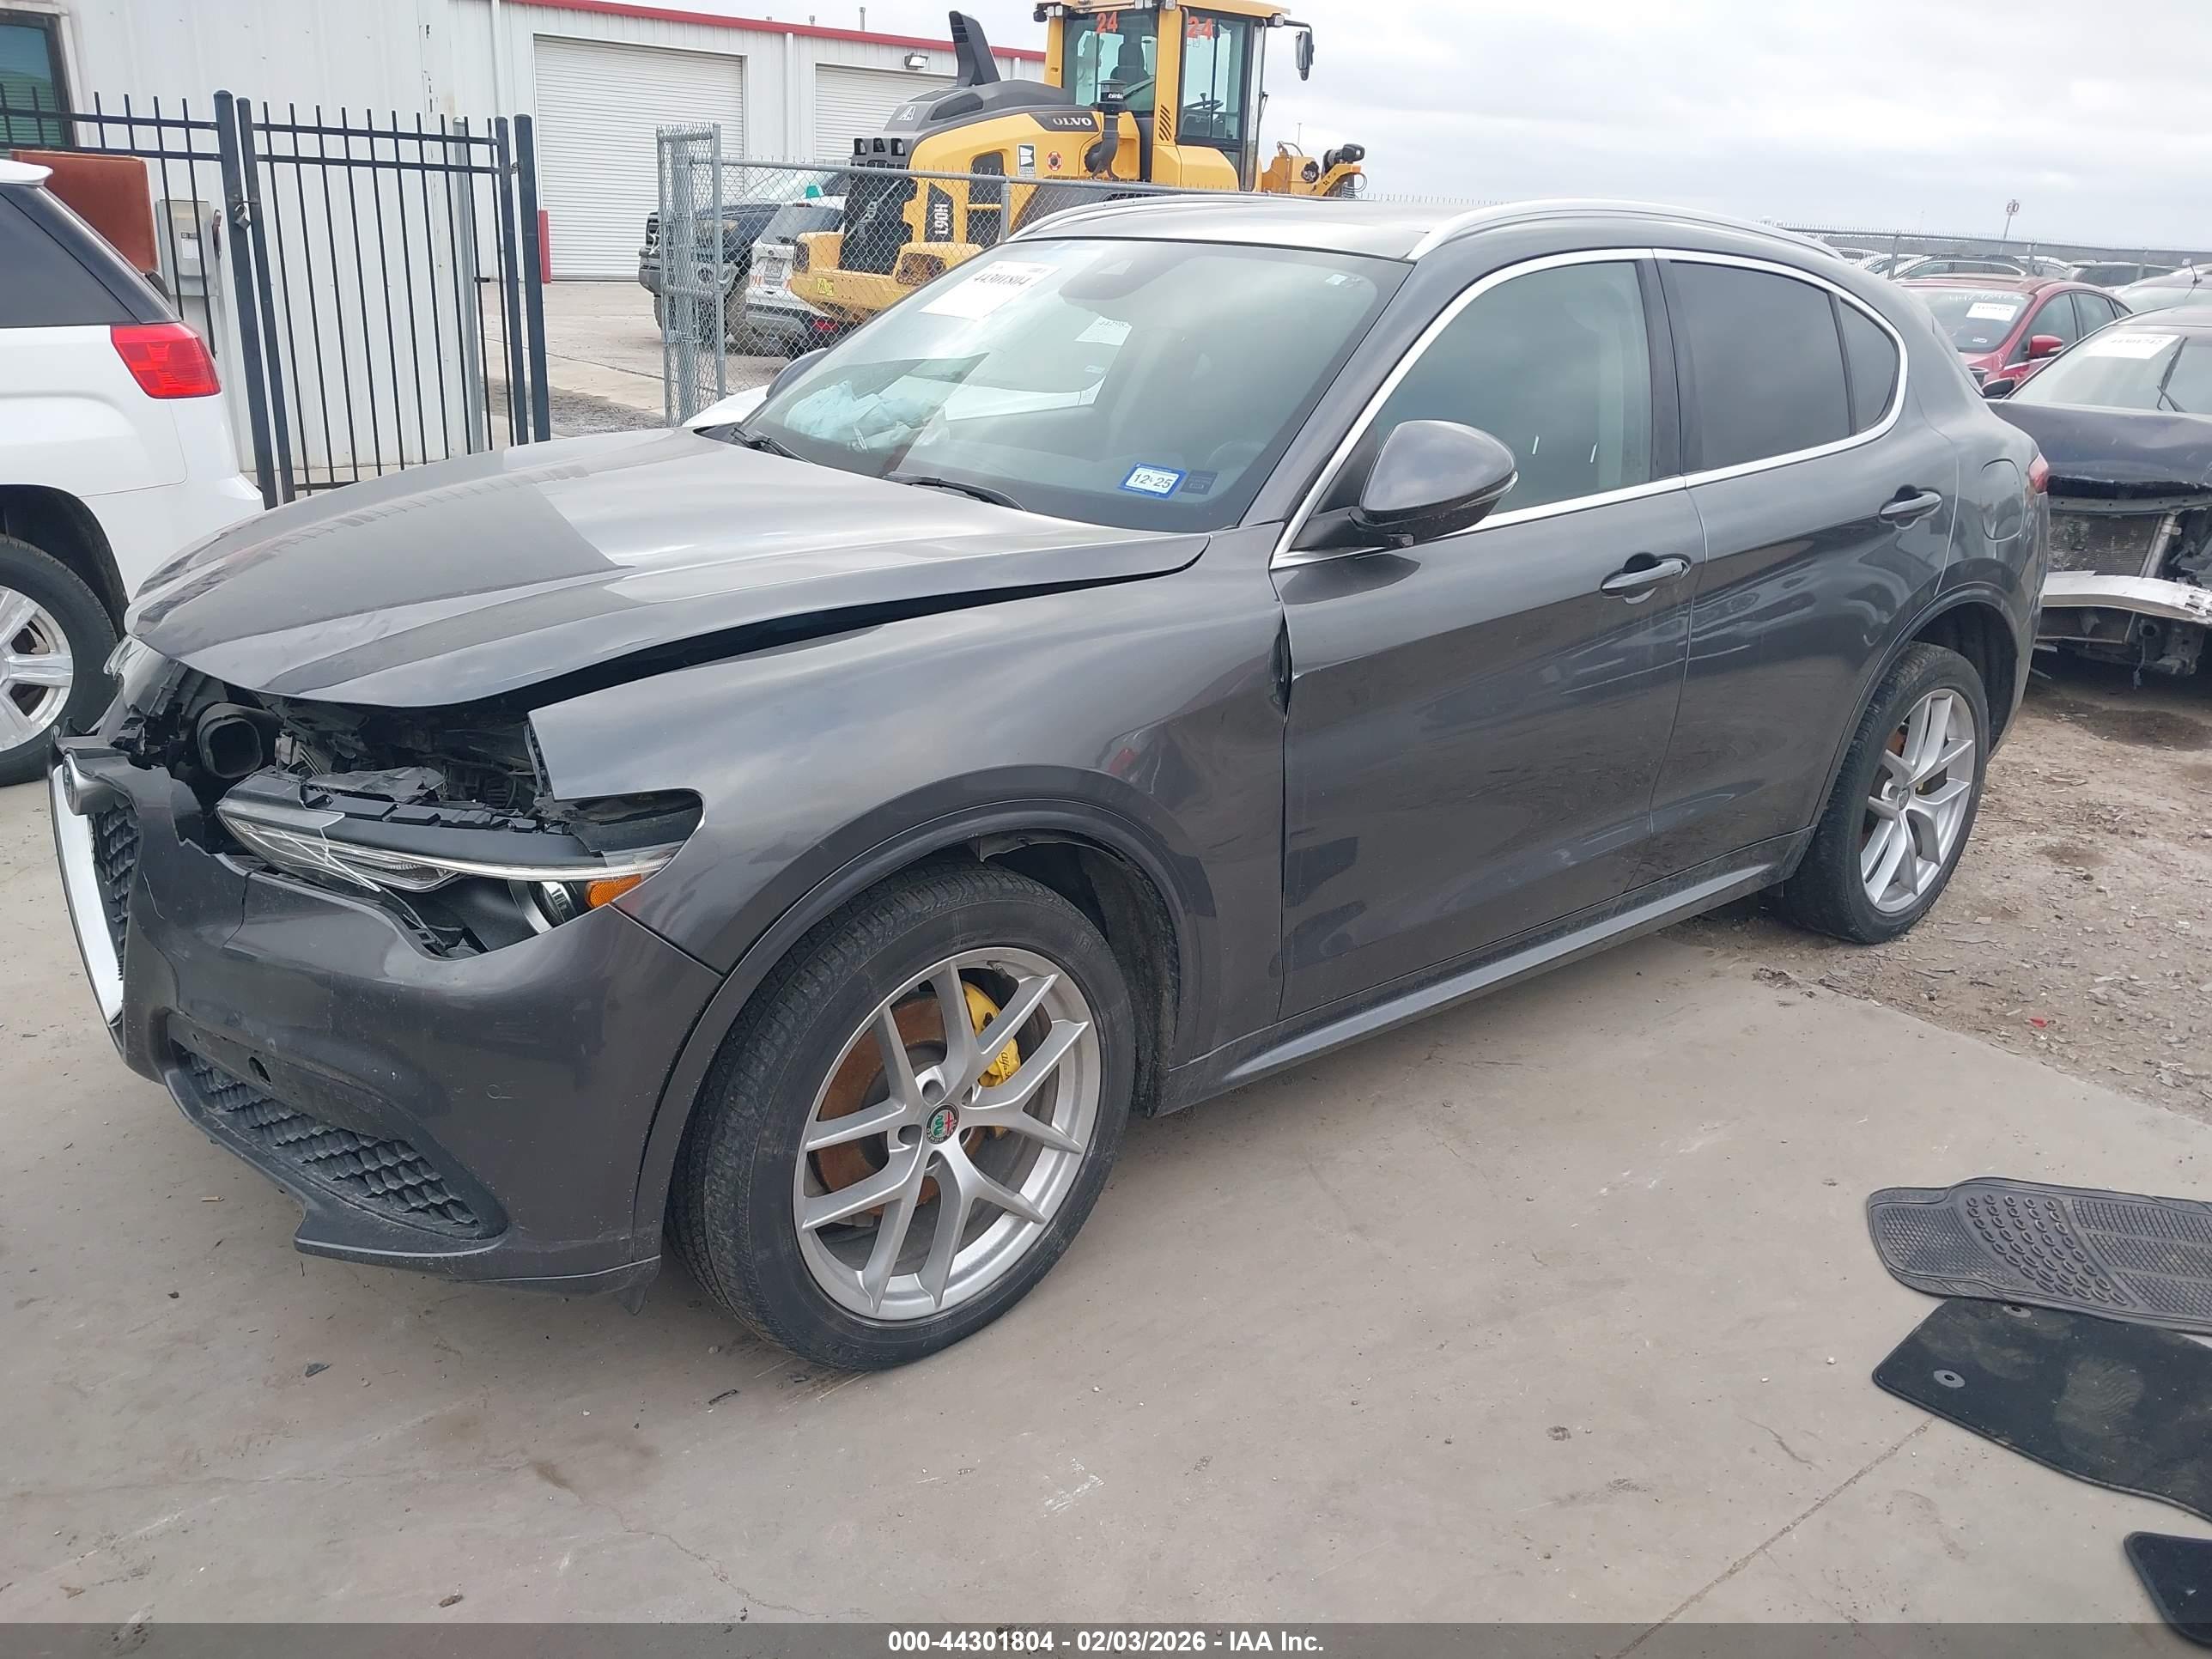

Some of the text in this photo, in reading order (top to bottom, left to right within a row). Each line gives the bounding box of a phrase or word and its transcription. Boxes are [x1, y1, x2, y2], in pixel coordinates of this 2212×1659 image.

[1096, 11, 1118, 33] 24
[1188, 16, 1213, 40] 24
[934, 204, 949, 234] L90H
[1133, 473, 1173, 489] 12 25
